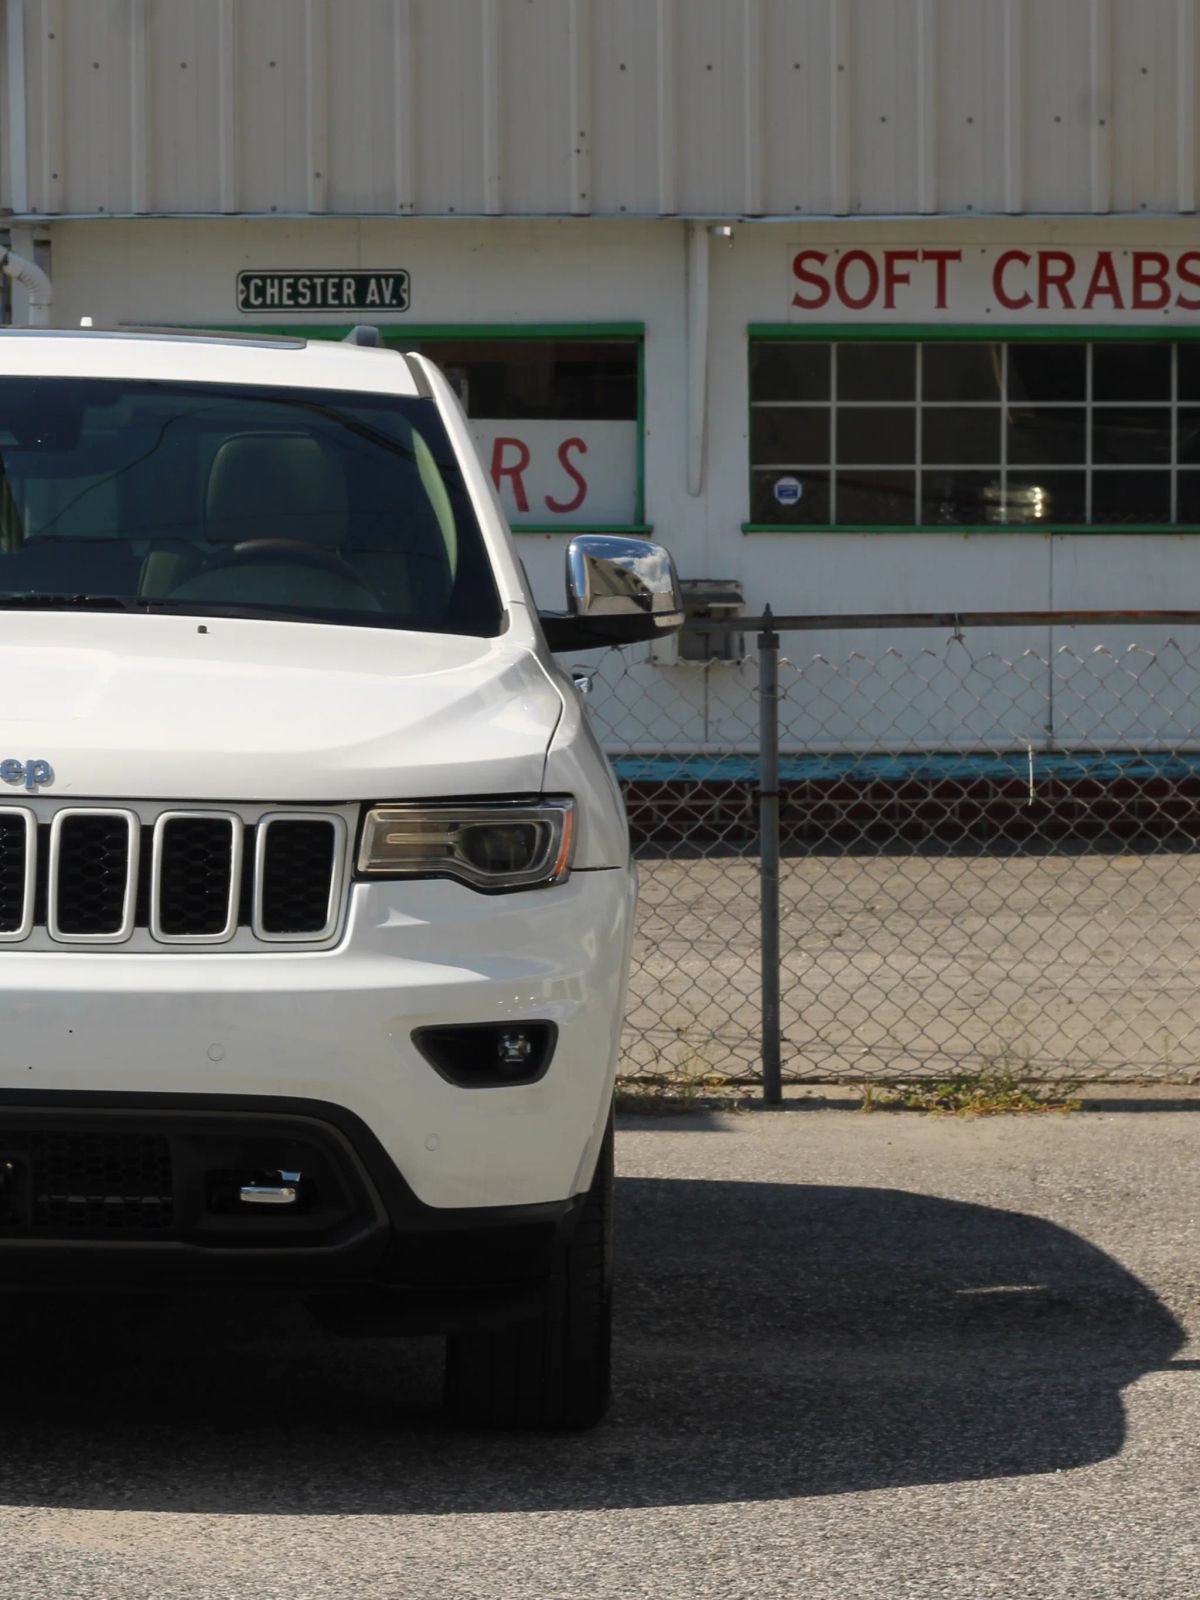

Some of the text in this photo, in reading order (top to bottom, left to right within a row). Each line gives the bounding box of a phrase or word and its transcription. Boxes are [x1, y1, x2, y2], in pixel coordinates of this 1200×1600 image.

[249, 278, 398, 305] CHESTER AV.
[791, 249, 1200, 310] SOFT CRABS
